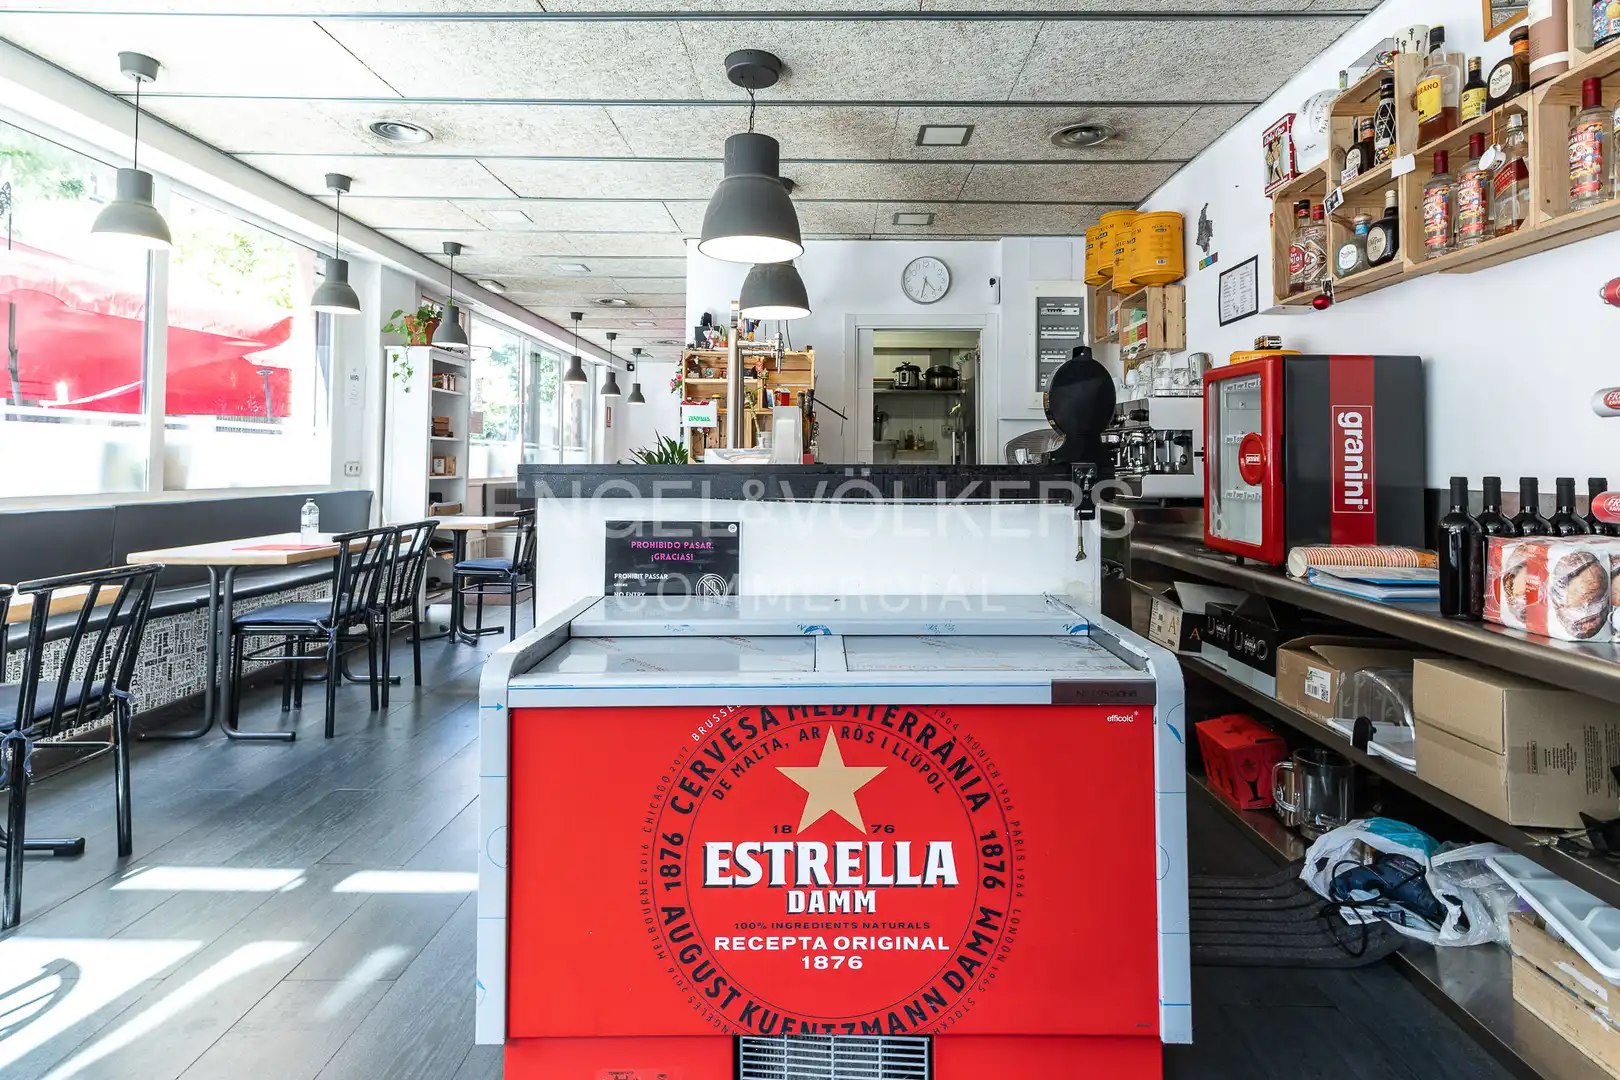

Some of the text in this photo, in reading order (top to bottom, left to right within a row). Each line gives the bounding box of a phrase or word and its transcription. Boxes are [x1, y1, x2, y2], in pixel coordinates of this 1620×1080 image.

[1337, 411, 1369, 505] granini
[631, 541, 714, 549] PROHIBIDO PASAR.
[651, 553, 694, 562] ¡GRACIAS!
[670, 706, 780, 815] CERVESA
[711, 779, 732, 800] DE
[891, 742, 947, 794] LLÚPOL
[964, 733, 1014, 811] MUNICH 1906
[643, 746, 690, 833] CHICAGO 2017
[772, 824, 794, 835] 18
[869, 824, 895, 834] 76
[1011, 820, 1027, 861] PARIS
[660, 832, 684, 892] 1876
[702, 841, 960, 889] ESTRELLA
[979, 829, 1006, 889] 1876
[639, 844, 668, 960] MELBOURNE 2016
[786, 889, 877, 914] DAMM
[714, 936, 950, 951] RECEPTA ORIGINAL
[735, 922, 931, 930] 100% INGREDIENTS NATURALS
[996, 908, 1022, 963] LONDON
[661, 905, 742, 1010] AUGUST
[941, 905, 1004, 994] DAMM
[801, 955, 864, 970] 1876
[926, 997, 976, 1036] STOCKH
